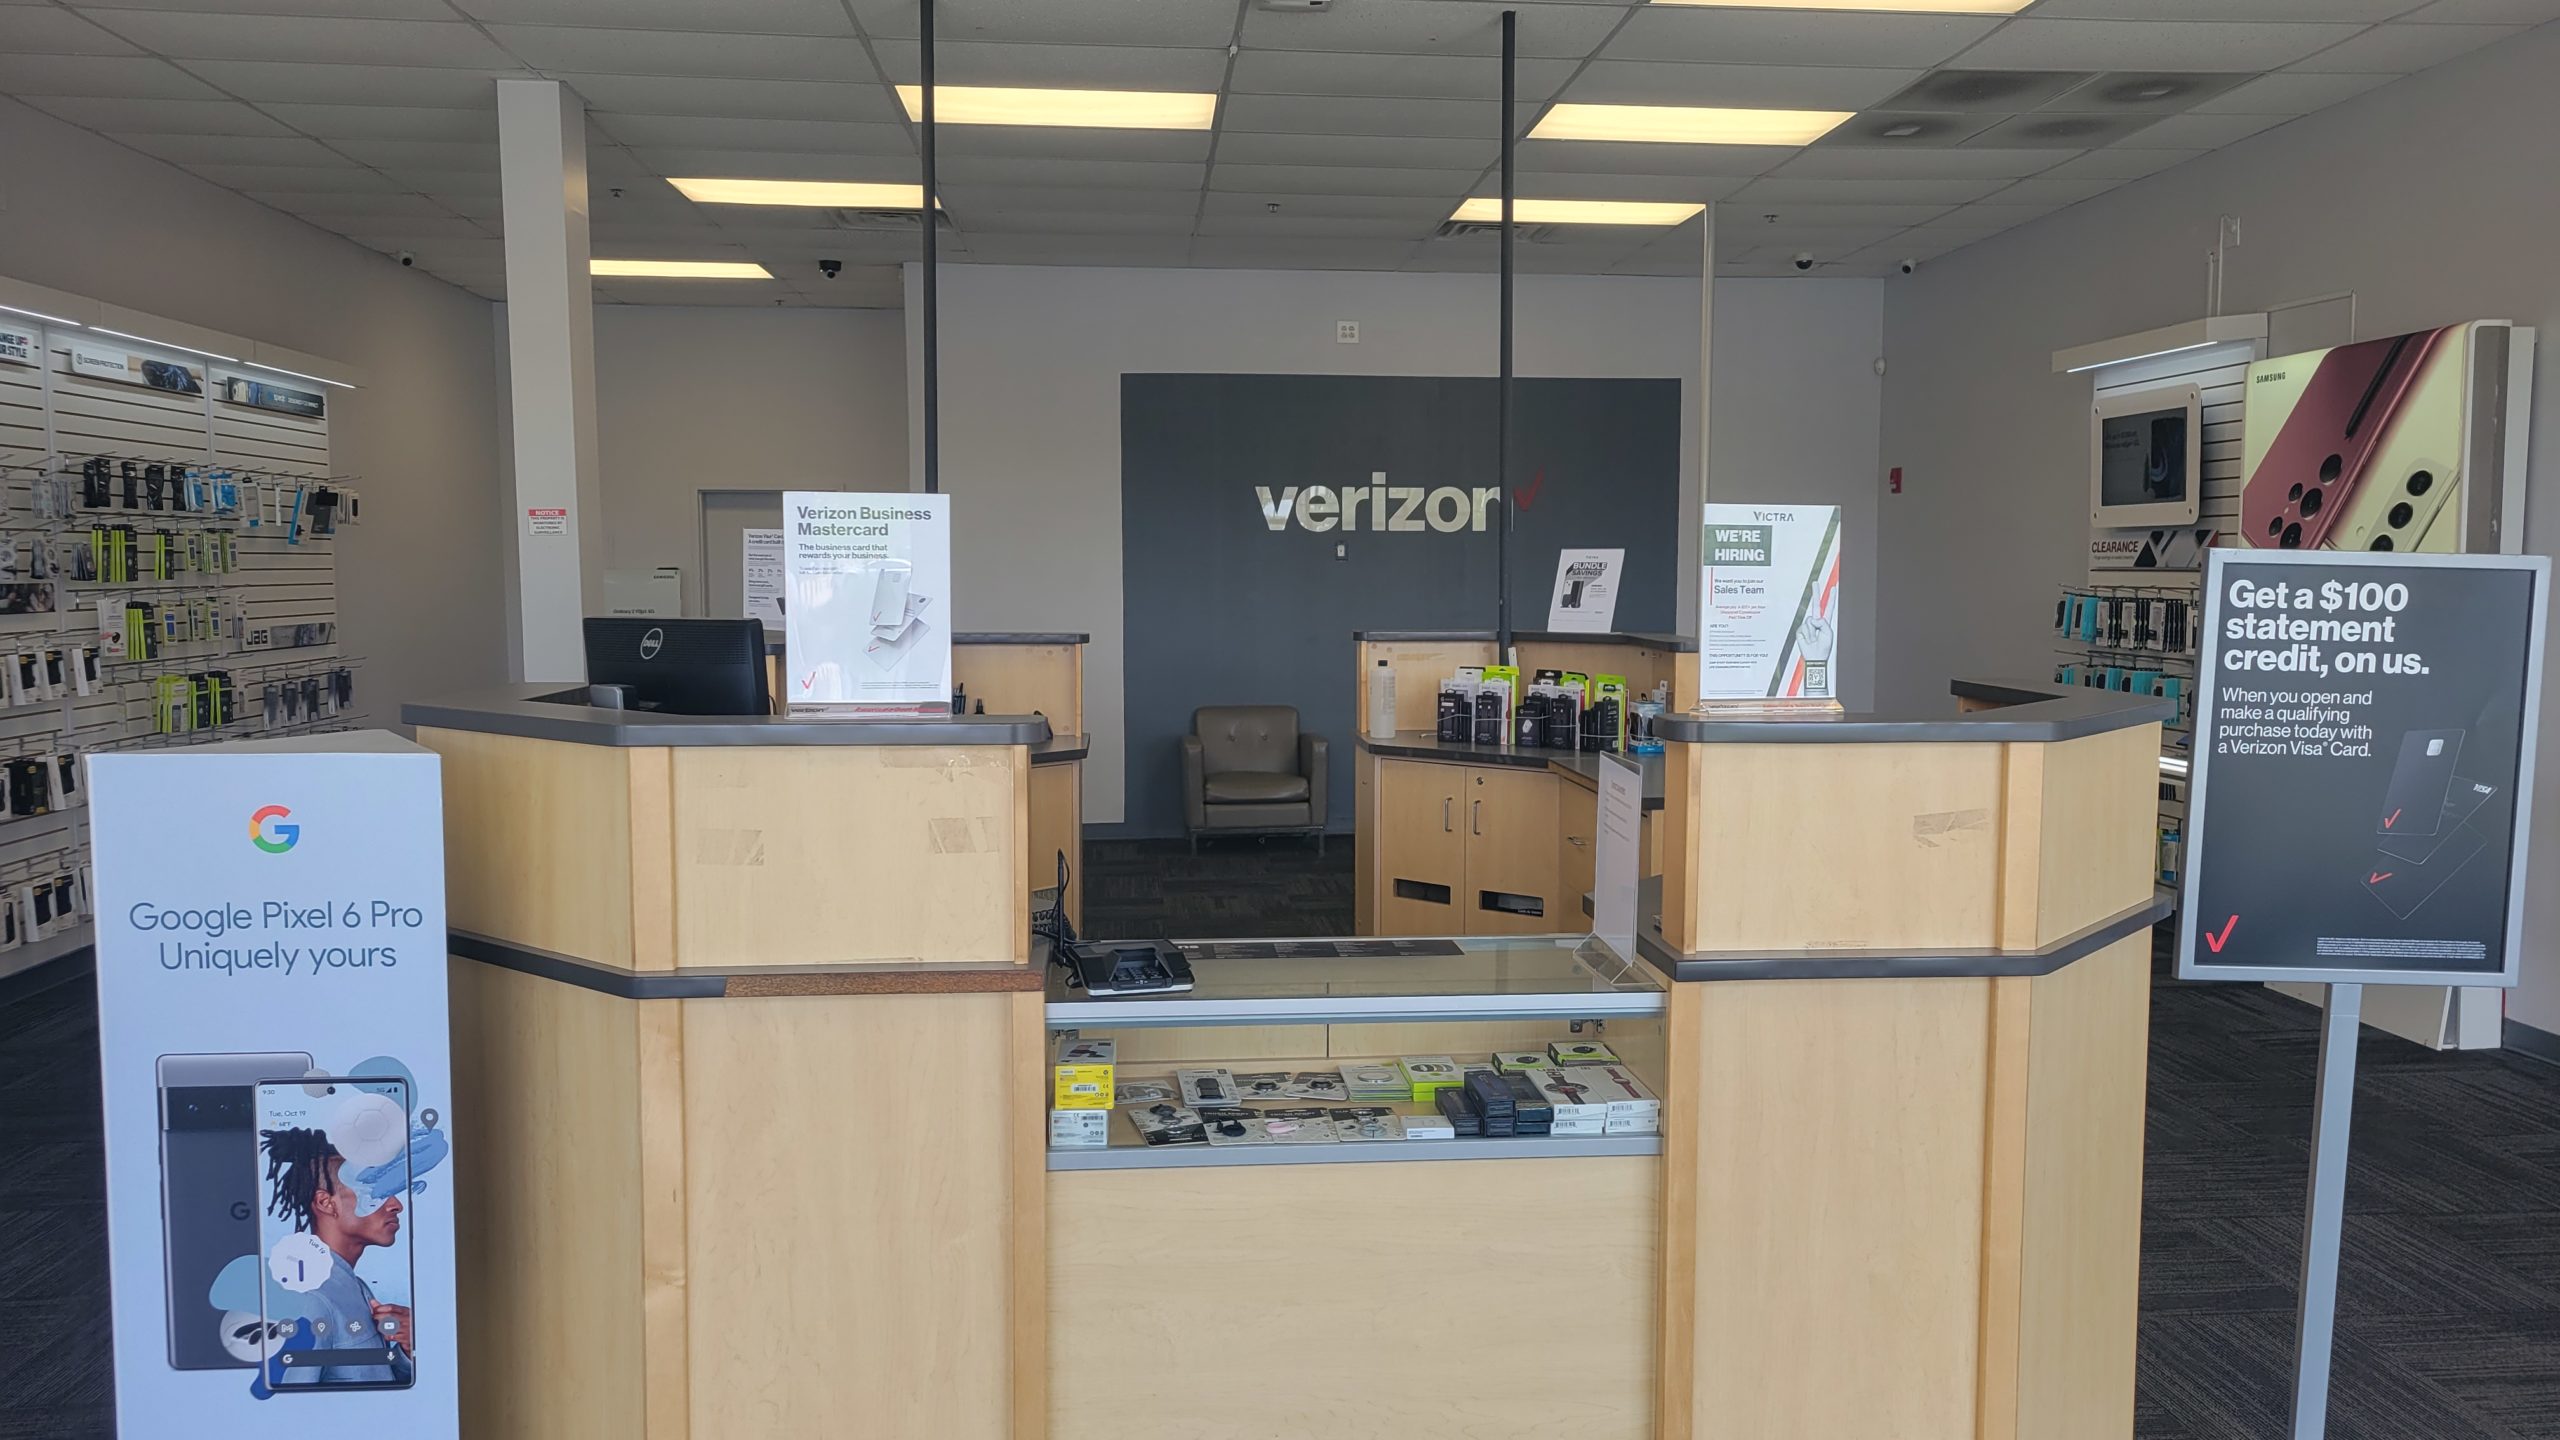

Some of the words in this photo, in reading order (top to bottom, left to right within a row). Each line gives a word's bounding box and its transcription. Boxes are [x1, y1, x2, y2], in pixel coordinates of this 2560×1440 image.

[8, 346, 27, 358] STYLE
[2256, 371, 2286, 384] SAMSUNG
[797, 506, 857, 520] Verizon
[860, 506, 932, 520] Business
[1753, 511, 1794, 522] VICTRA
[798, 523, 889, 536] Mastercard
[1715, 529, 1761, 542] WE'RE
[799, 543, 814, 551] The
[815, 543, 851, 551] business
[2091, 541, 2139, 553] CLEARANCE
[1714, 548, 1765, 561] HIRING
[1573, 562, 1607, 570] BUNDLE
[1714, 585, 1739, 594] Sales
[1739, 585, 1765, 594] Team
[2229, 579, 2289, 609] Get
[2293, 588, 2313, 610] a
[2319, 579, 2409, 613] $100
[2226, 613, 2396, 643] statement
[2224, 643, 2328, 679] credit,
[2334, 651, 2377, 673] on
[2382, 653, 2430, 674] us.
[2222, 687, 2267, 703] When
[2270, 692, 2298, 706] you
[2301, 692, 2340, 706] open
[2342, 690, 2373, 705] and
[2220, 705, 2262, 720] make
[2264, 709, 2275, 720] a
[2276, 706, 2350, 725] qualifying
[2219, 722, 2291, 739] purchase
[2294, 724, 2338, 742] today
[2340, 725, 2373, 740] with
[2218, 743, 2228, 754] a
[2231, 739, 2287, 755] Verizon
[2330, 741, 2372, 757] Card.
[2473, 783, 2492, 794] VISA
[129, 902, 253, 938] Google
[262, 901, 333, 929] Pixel
[342, 902, 361, 929] 6
[371, 900, 423, 928] Pro
[160, 941, 300, 977] Uniquely
[308, 947, 397, 976] yours
[309, 1238, 320, 1249] Tue
